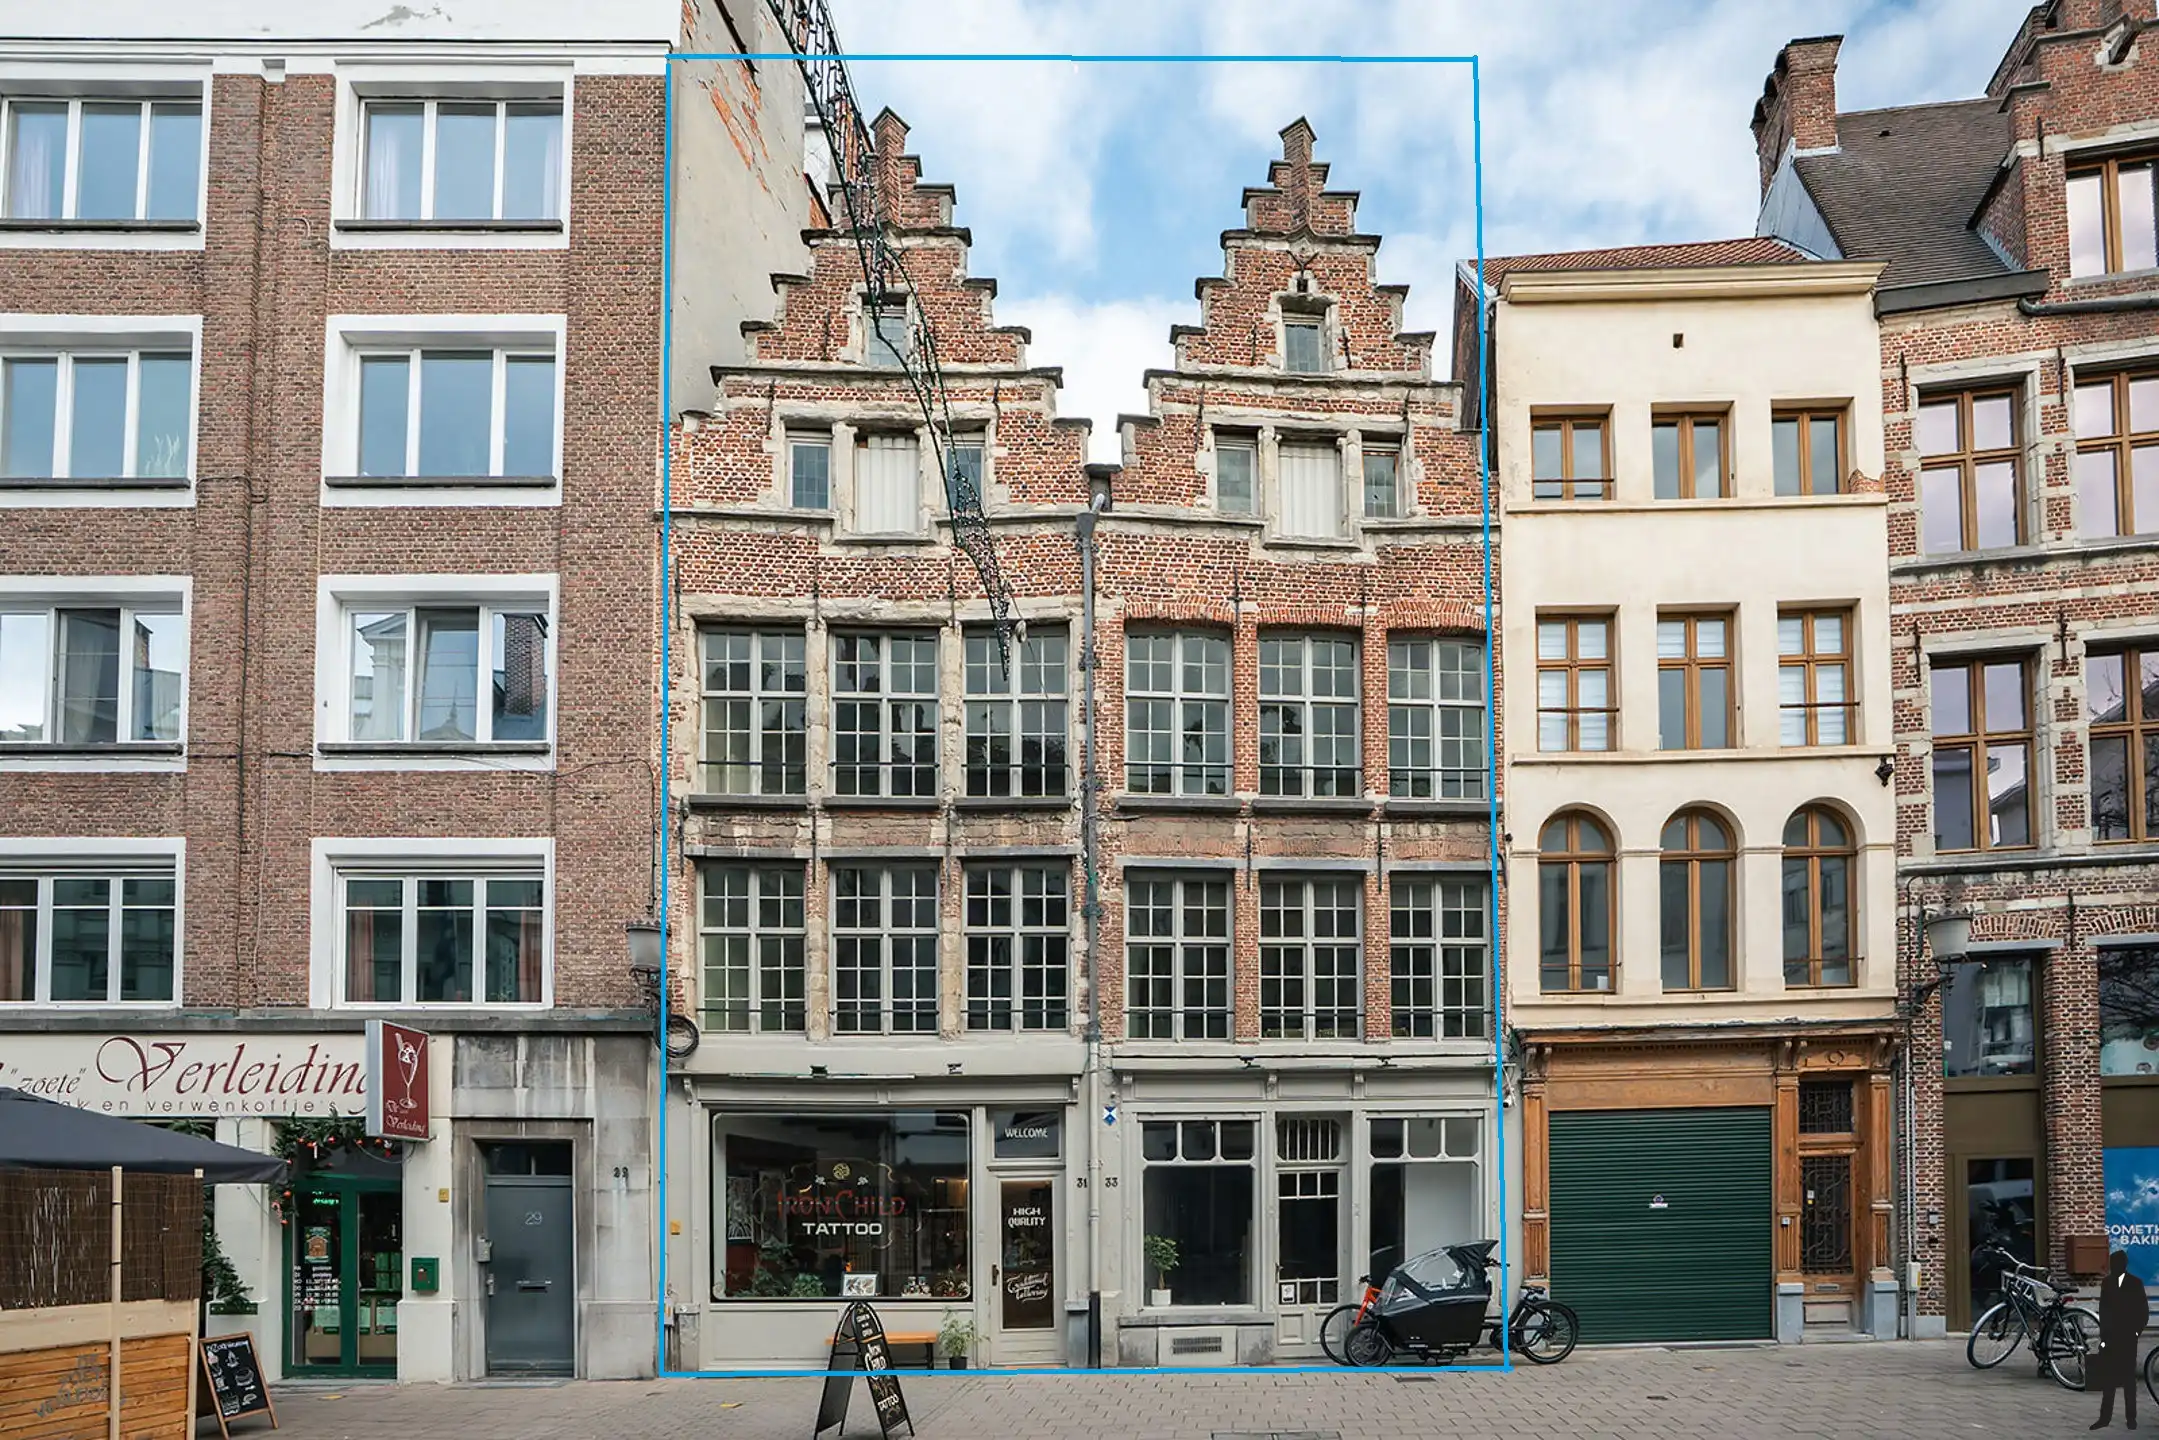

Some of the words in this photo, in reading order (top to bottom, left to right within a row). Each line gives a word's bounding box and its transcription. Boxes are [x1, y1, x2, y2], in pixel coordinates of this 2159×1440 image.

[101, 1100, 129, 1112] en
[1004, 1127, 1048, 1138] WELCOME
[1077, 1178, 1088, 1188] 31
[1105, 1177, 1118, 1188] 33
[1013, 1207, 1041, 1216] HIGH
[525, 1211, 542, 1225] 29
[1007, 1216, 1047, 1229] QUALITY
[802, 1222, 883, 1235] TATTOO
